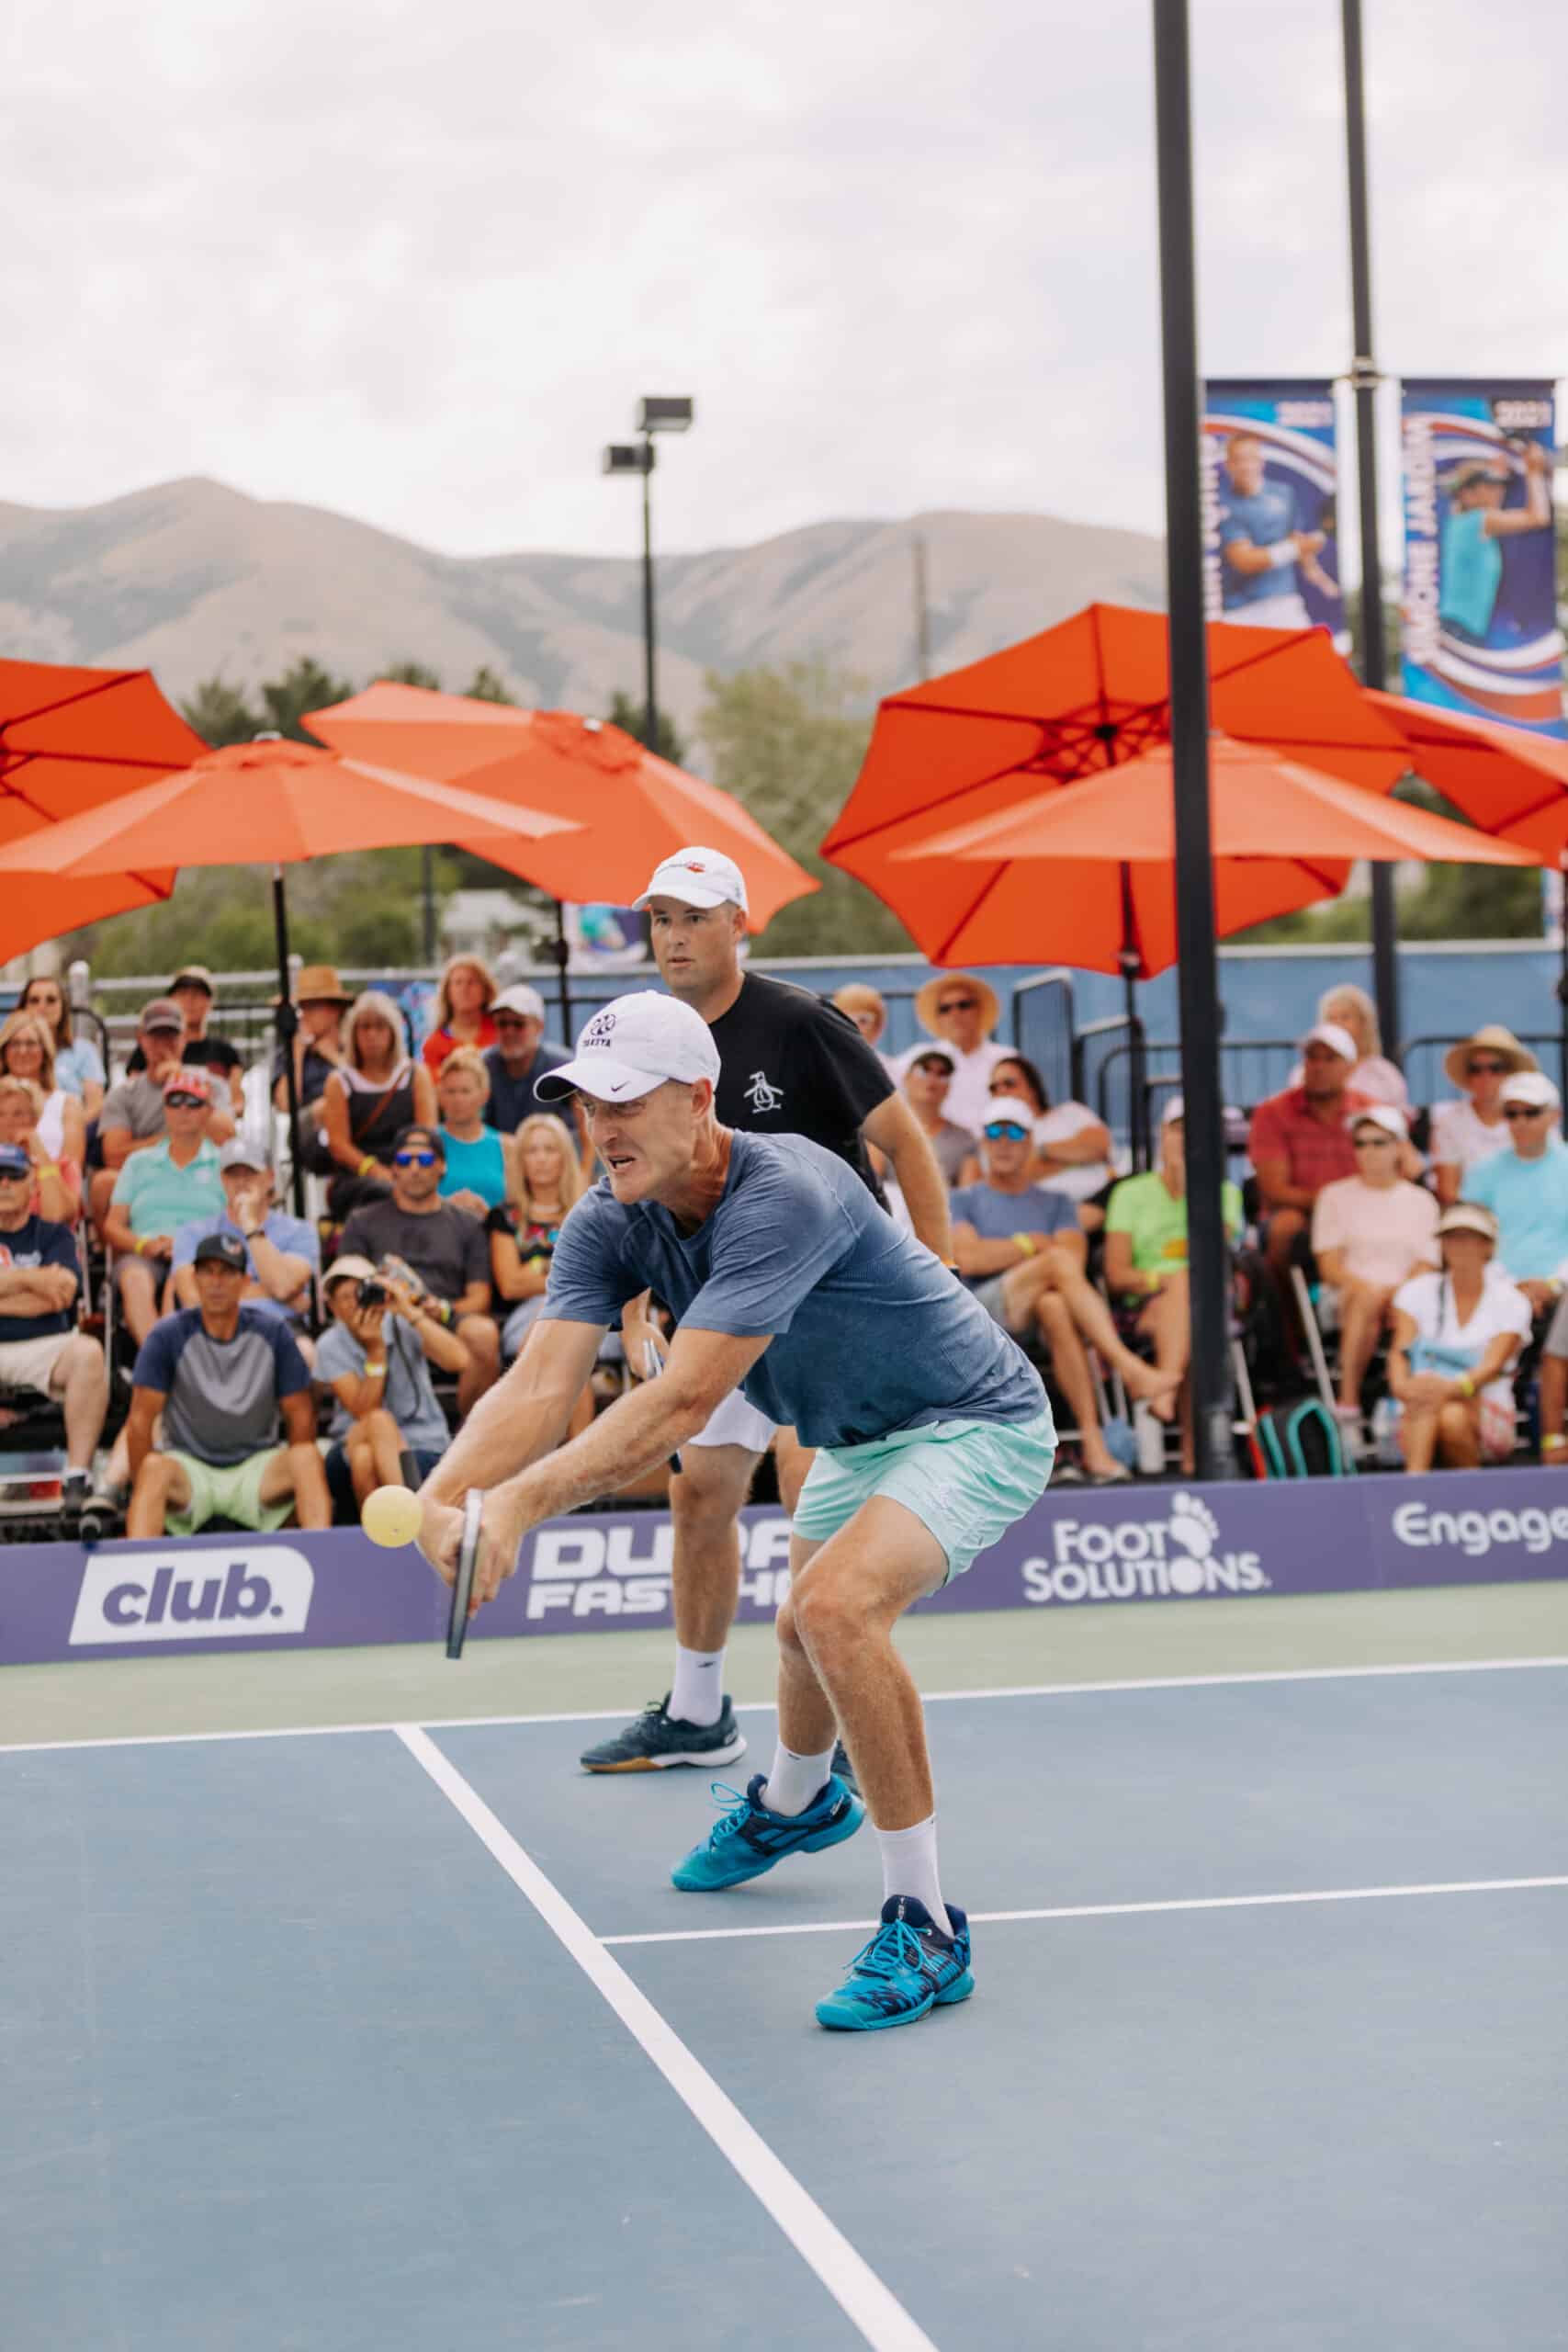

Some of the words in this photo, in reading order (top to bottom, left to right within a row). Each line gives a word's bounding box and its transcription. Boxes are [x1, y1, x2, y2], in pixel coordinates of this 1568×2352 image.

[531, 1518, 794, 1582] DUA
[1053, 1520, 1168, 1563] FOOT
[102, 1562, 284, 1627] club.
